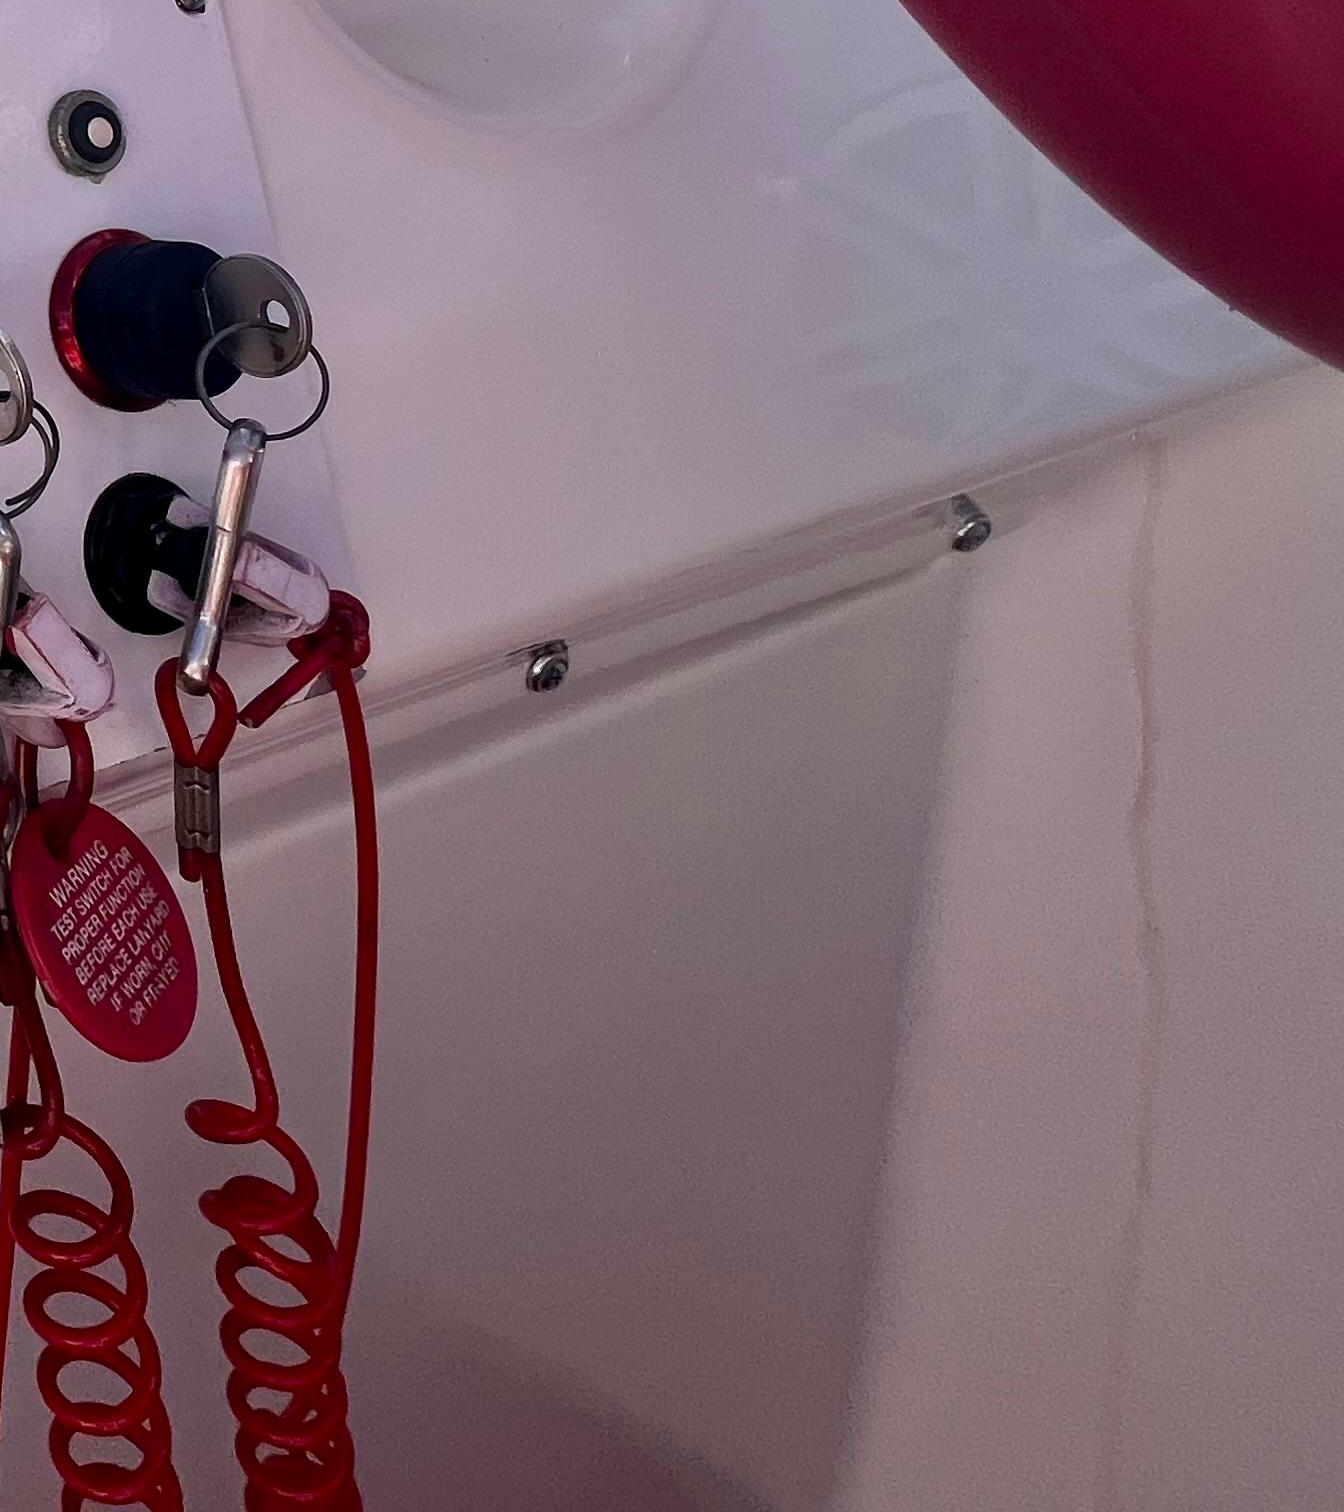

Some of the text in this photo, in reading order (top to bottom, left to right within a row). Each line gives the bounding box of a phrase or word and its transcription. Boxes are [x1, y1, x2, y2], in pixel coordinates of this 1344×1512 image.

[49, 840, 109, 908] WARNING
[50, 846, 133, 942] TEST SWITCH FOR
[61, 863, 146, 966] PROPER FUNCTION
[75, 881, 159, 986] BEFORE EACH USE
[86, 948, 132, 1006] REPLACE
[109, 992, 123, 1012] IF
[129, 1000, 148, 1026] OR
